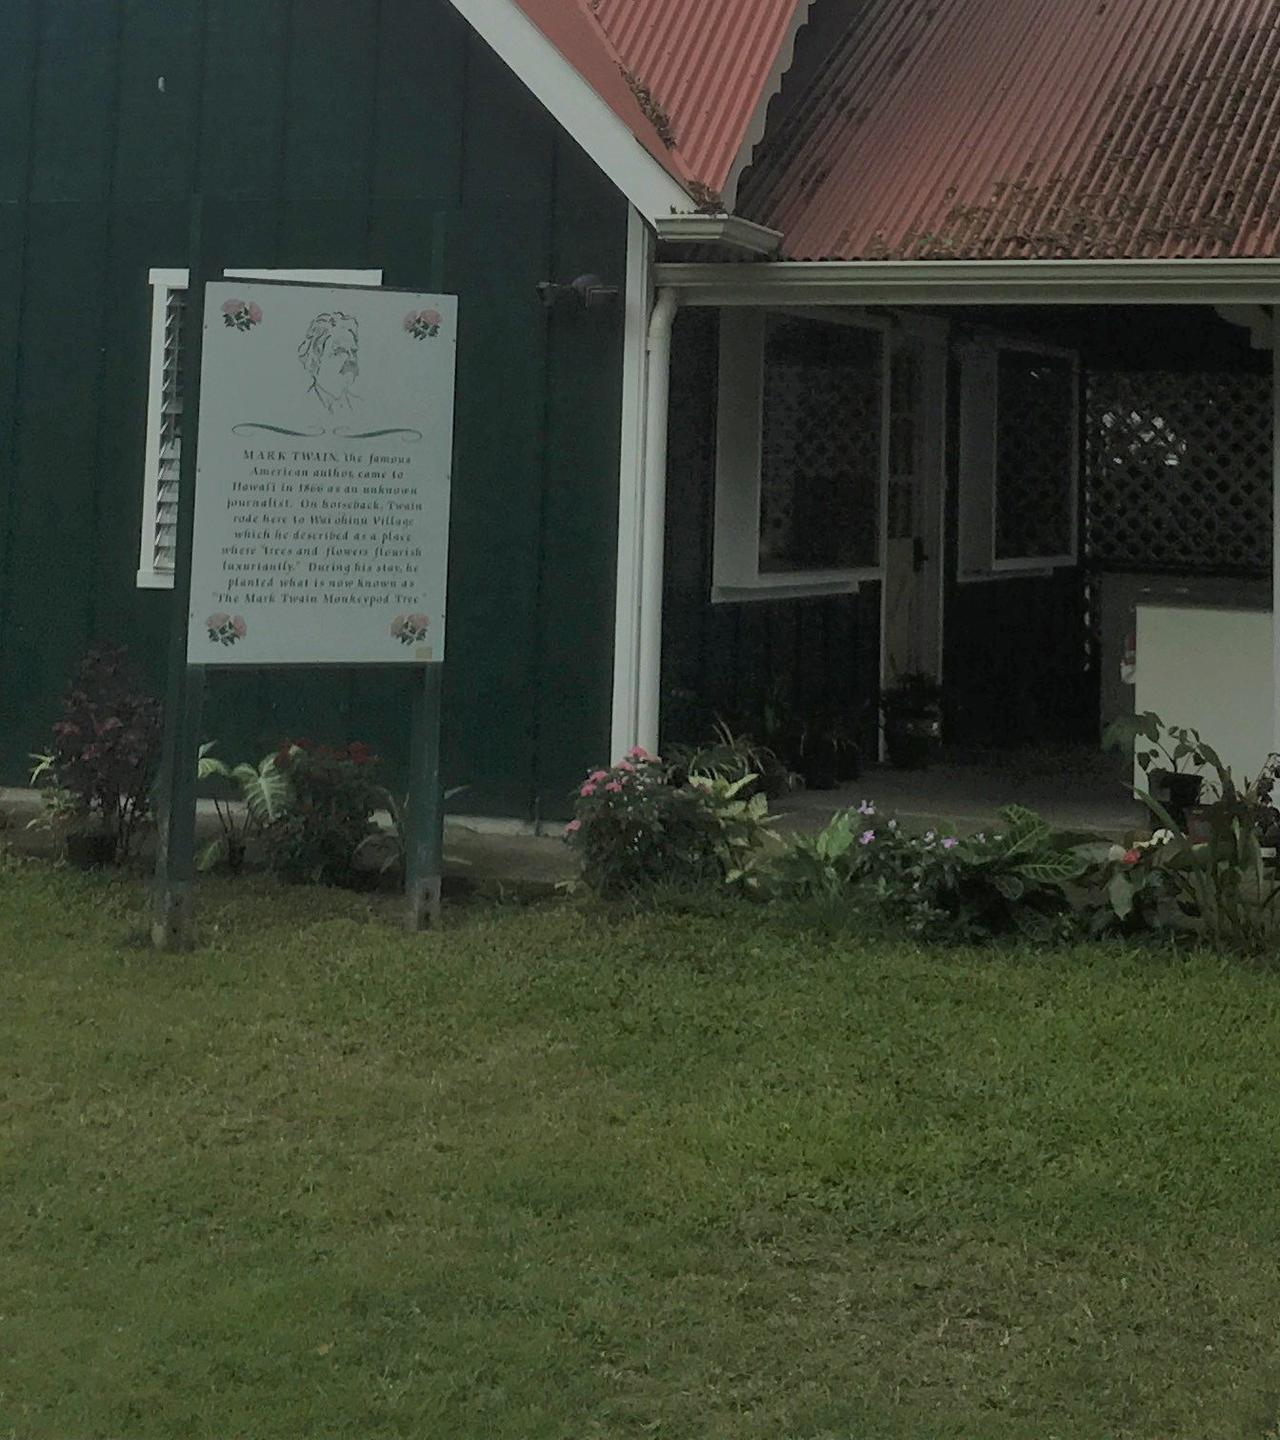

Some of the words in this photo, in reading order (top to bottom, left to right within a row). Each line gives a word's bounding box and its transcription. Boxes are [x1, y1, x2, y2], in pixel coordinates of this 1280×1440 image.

[243, 449, 287, 461] MARK
[344, 453, 362, 463] the
[368, 453, 411, 465] famous
[250, 466, 308, 477] American
[357, 471, 386, 479] came
[391, 470, 404, 479] to
[280, 482, 293, 493] in
[327, 486, 341, 494] as
[344, 486, 359, 494] an
[363, 484, 418, 495] unknown
[226, 497, 293, 510] journalist.
[300, 499, 318, 509] On
[387, 501, 423, 511] Twain
[233, 514, 259, 524] rode
[262, 514, 288, 524] here
[292, 515, 305, 525] to
[373, 515, 414, 528] Village
[233, 529, 270, 539] which
[274, 529, 289, 540] he
[293, 529, 349, 541] described
[353, 533, 366, 541] as
[370, 533, 377, 541] a
[381, 530, 412, 545] place
[222, 545, 257, 556] where
[296, 546, 319, 557] and
[325, 546, 368, 558] flowers
[374, 546, 422, 560] flourish
[308, 562, 351, 576] During
[354, 562, 373, 572] his
[406, 563, 419, 573] he
[227, 576, 274, 591] planted
[279, 577, 309, 588] what
[313, 578, 325, 588] is
[329, 580, 354, 589] now
[357, 578, 397, 589] known
[401, 580, 415, 589] as
[245, 593, 275, 604] Mark
[280, 593, 318, 604] Twain
[322, 593, 389, 608] Monkeypod
